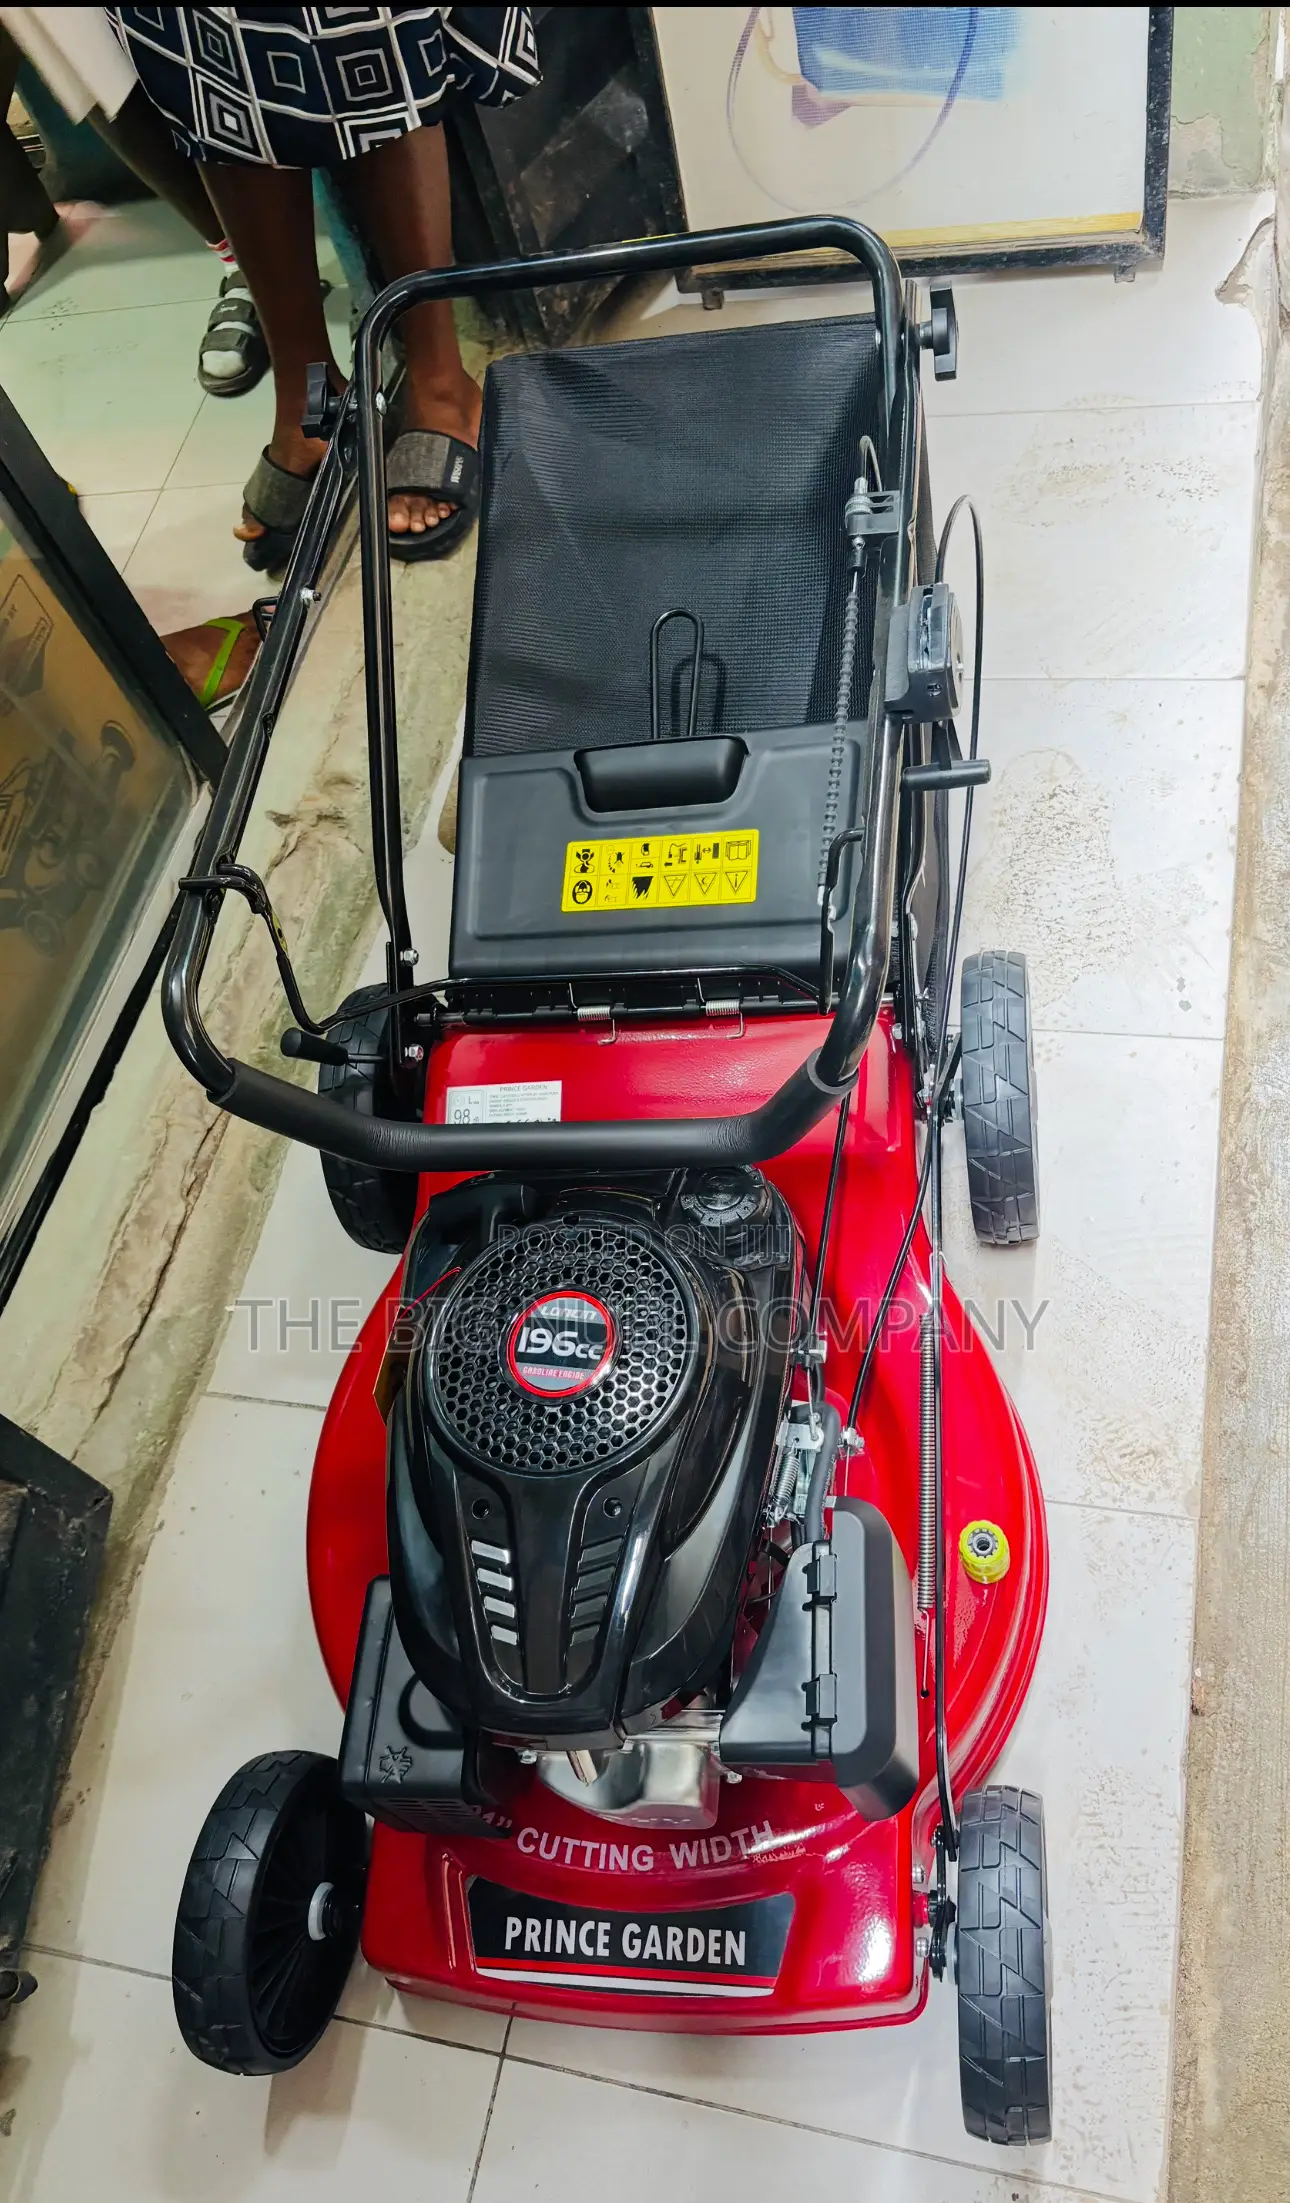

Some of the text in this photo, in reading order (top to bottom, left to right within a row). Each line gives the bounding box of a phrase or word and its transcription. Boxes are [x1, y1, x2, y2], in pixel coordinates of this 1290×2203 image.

[500, 1084, 548, 1093] PRINCE GARDEN
[454, 1108, 471, 1124] 98
[522, 1365, 585, 1380] GASOLINE ENGINE
[516, 1826, 655, 1872] CUTTING
[668, 1820, 776, 1870] WIDTH
[504, 1916, 747, 1967] PRINCE GARDEN
